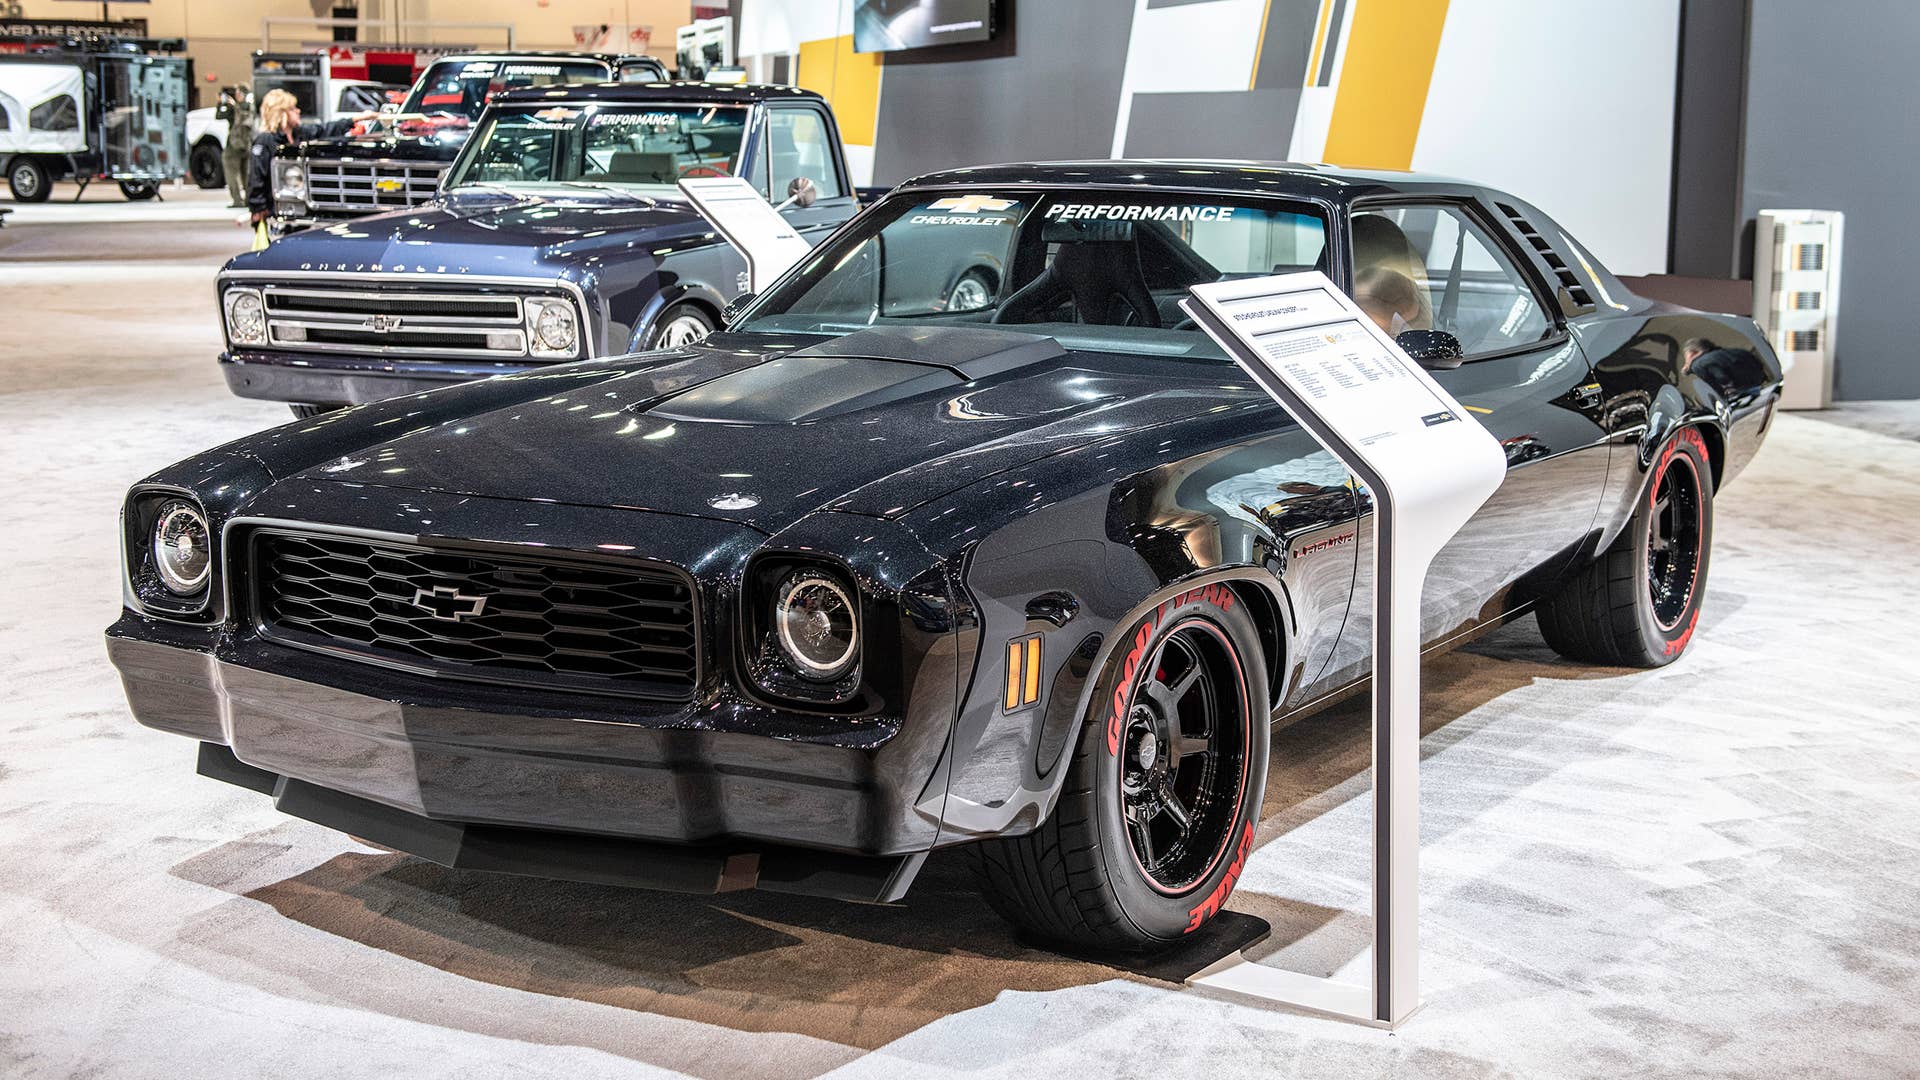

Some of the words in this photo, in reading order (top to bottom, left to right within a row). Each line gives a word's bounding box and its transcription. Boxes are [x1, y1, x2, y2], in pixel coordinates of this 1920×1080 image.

[36, 25, 64, 37] THE
[504, 65, 562, 76] PERFORMANCE
[592, 113, 678, 126] PERFORMANCE
[526, 122, 576, 131] CHEVROLET
[1044, 203, 1236, 223] PERFORMANCE
[909, 214, 1008, 226] CHEVROLET
[1183, 819, 1255, 934] EAGLE
